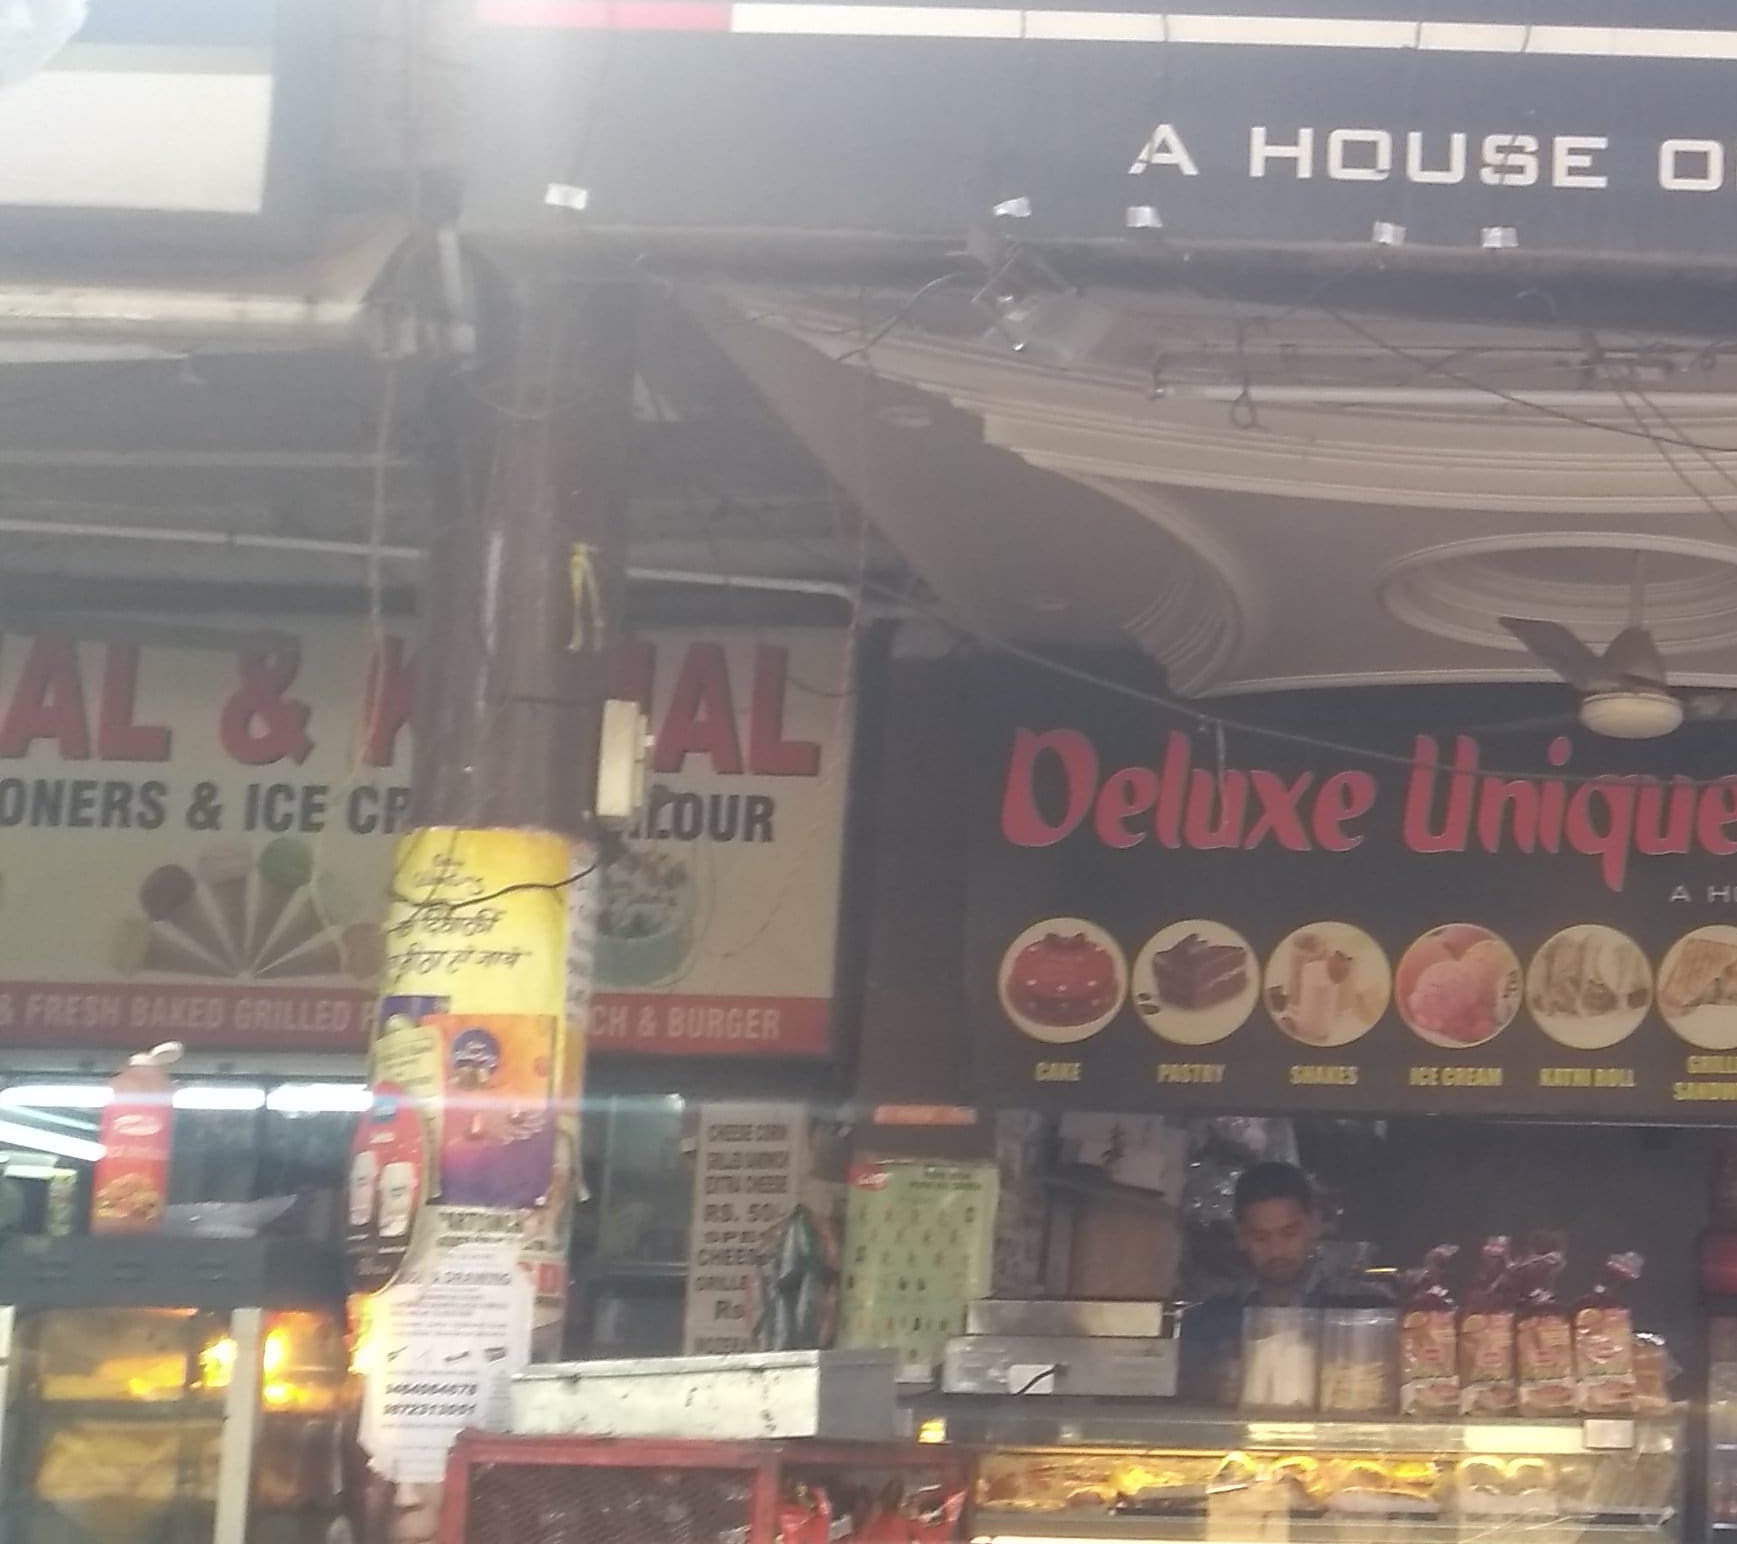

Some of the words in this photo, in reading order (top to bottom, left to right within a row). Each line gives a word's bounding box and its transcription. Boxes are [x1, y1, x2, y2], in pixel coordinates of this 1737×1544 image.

[1130, 124, 1200, 177] A
[1250, 126, 1608, 190] HOUSE
[220, 630, 316, 766] &
[186, 781, 224, 831] &
[245, 783, 329, 833] ICE
[1002, 727, 1377, 852] Deluxe
[1669, 884, 1692, 904] A
[25, 993, 121, 1027] FRESH
[131, 996, 226, 1029] BAKED
[234, 998, 356, 1032] GRILLED
[667, 1006, 781, 1040] BURGER
